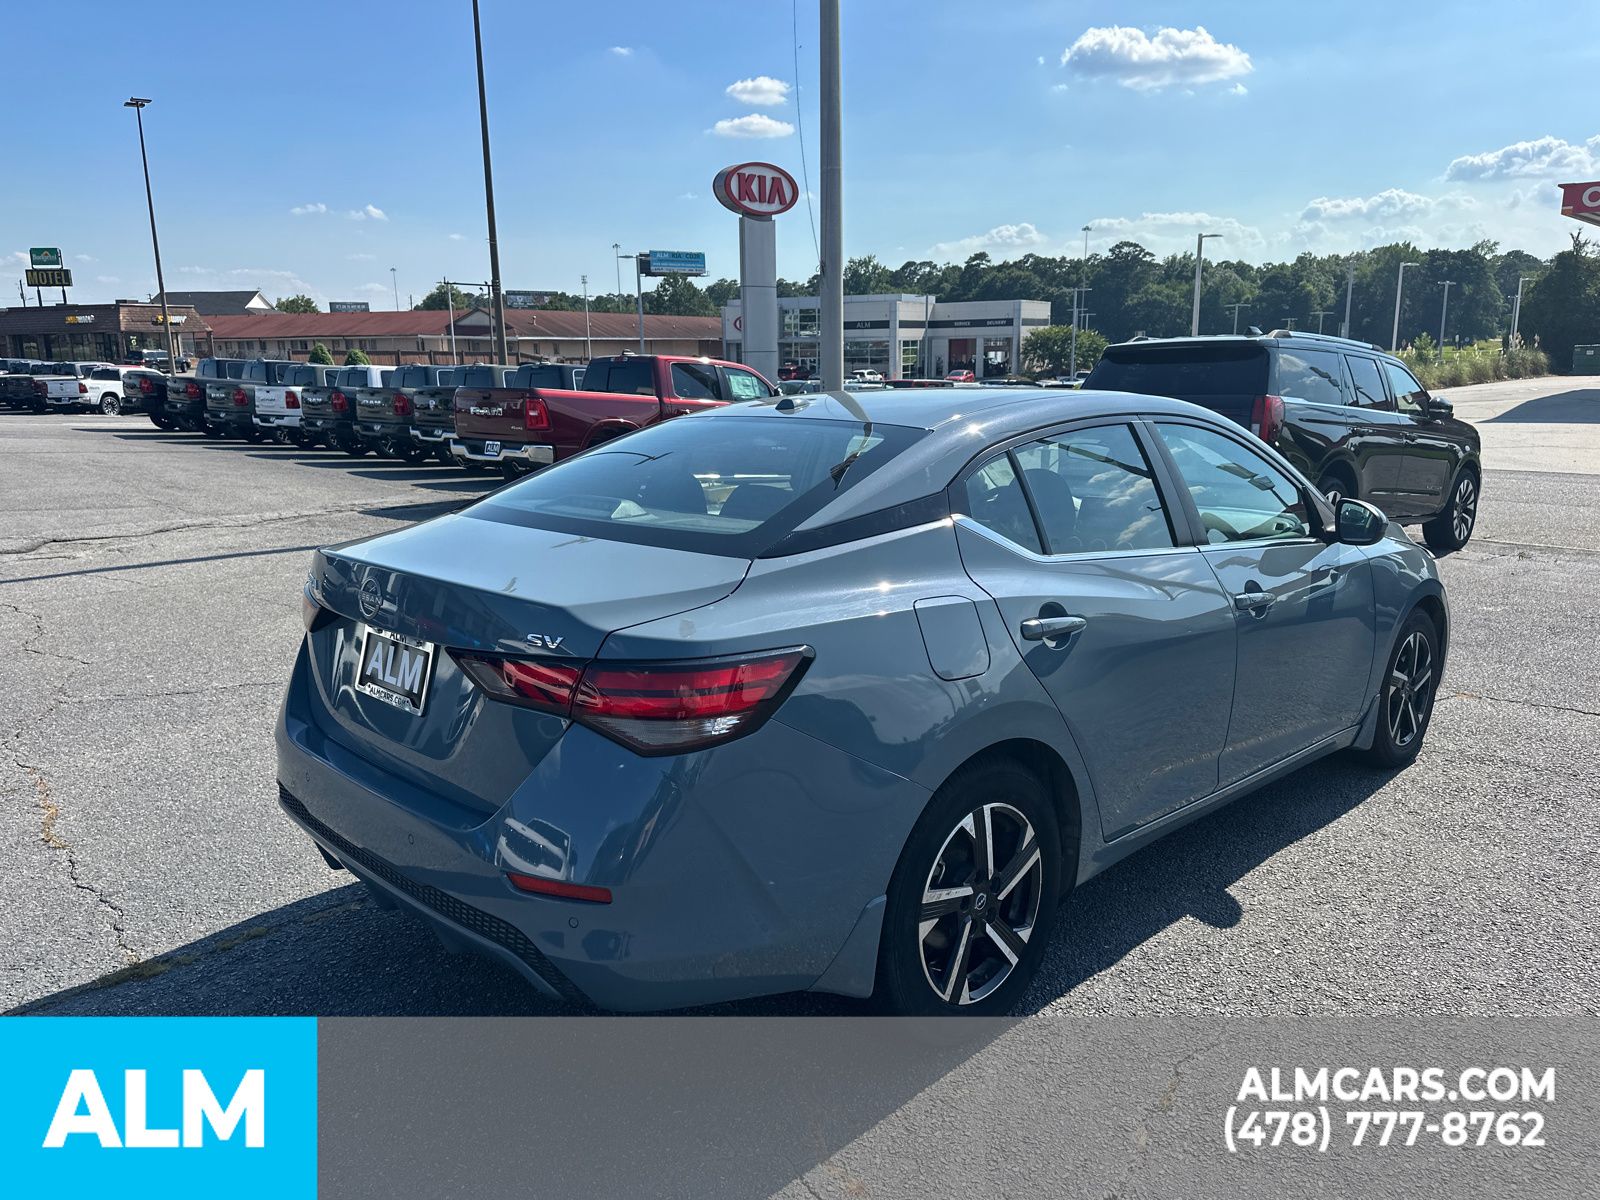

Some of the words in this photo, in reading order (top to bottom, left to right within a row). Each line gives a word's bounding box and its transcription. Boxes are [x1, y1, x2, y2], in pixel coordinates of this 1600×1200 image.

[737, 172, 788, 206] KIA
[27, 271, 69, 285] MOTEL
[486, 444, 500, 452] ALM
[389, 631, 408, 643] ALM
[526, 633, 564, 649] SV
[366, 641, 424, 695] ALM
